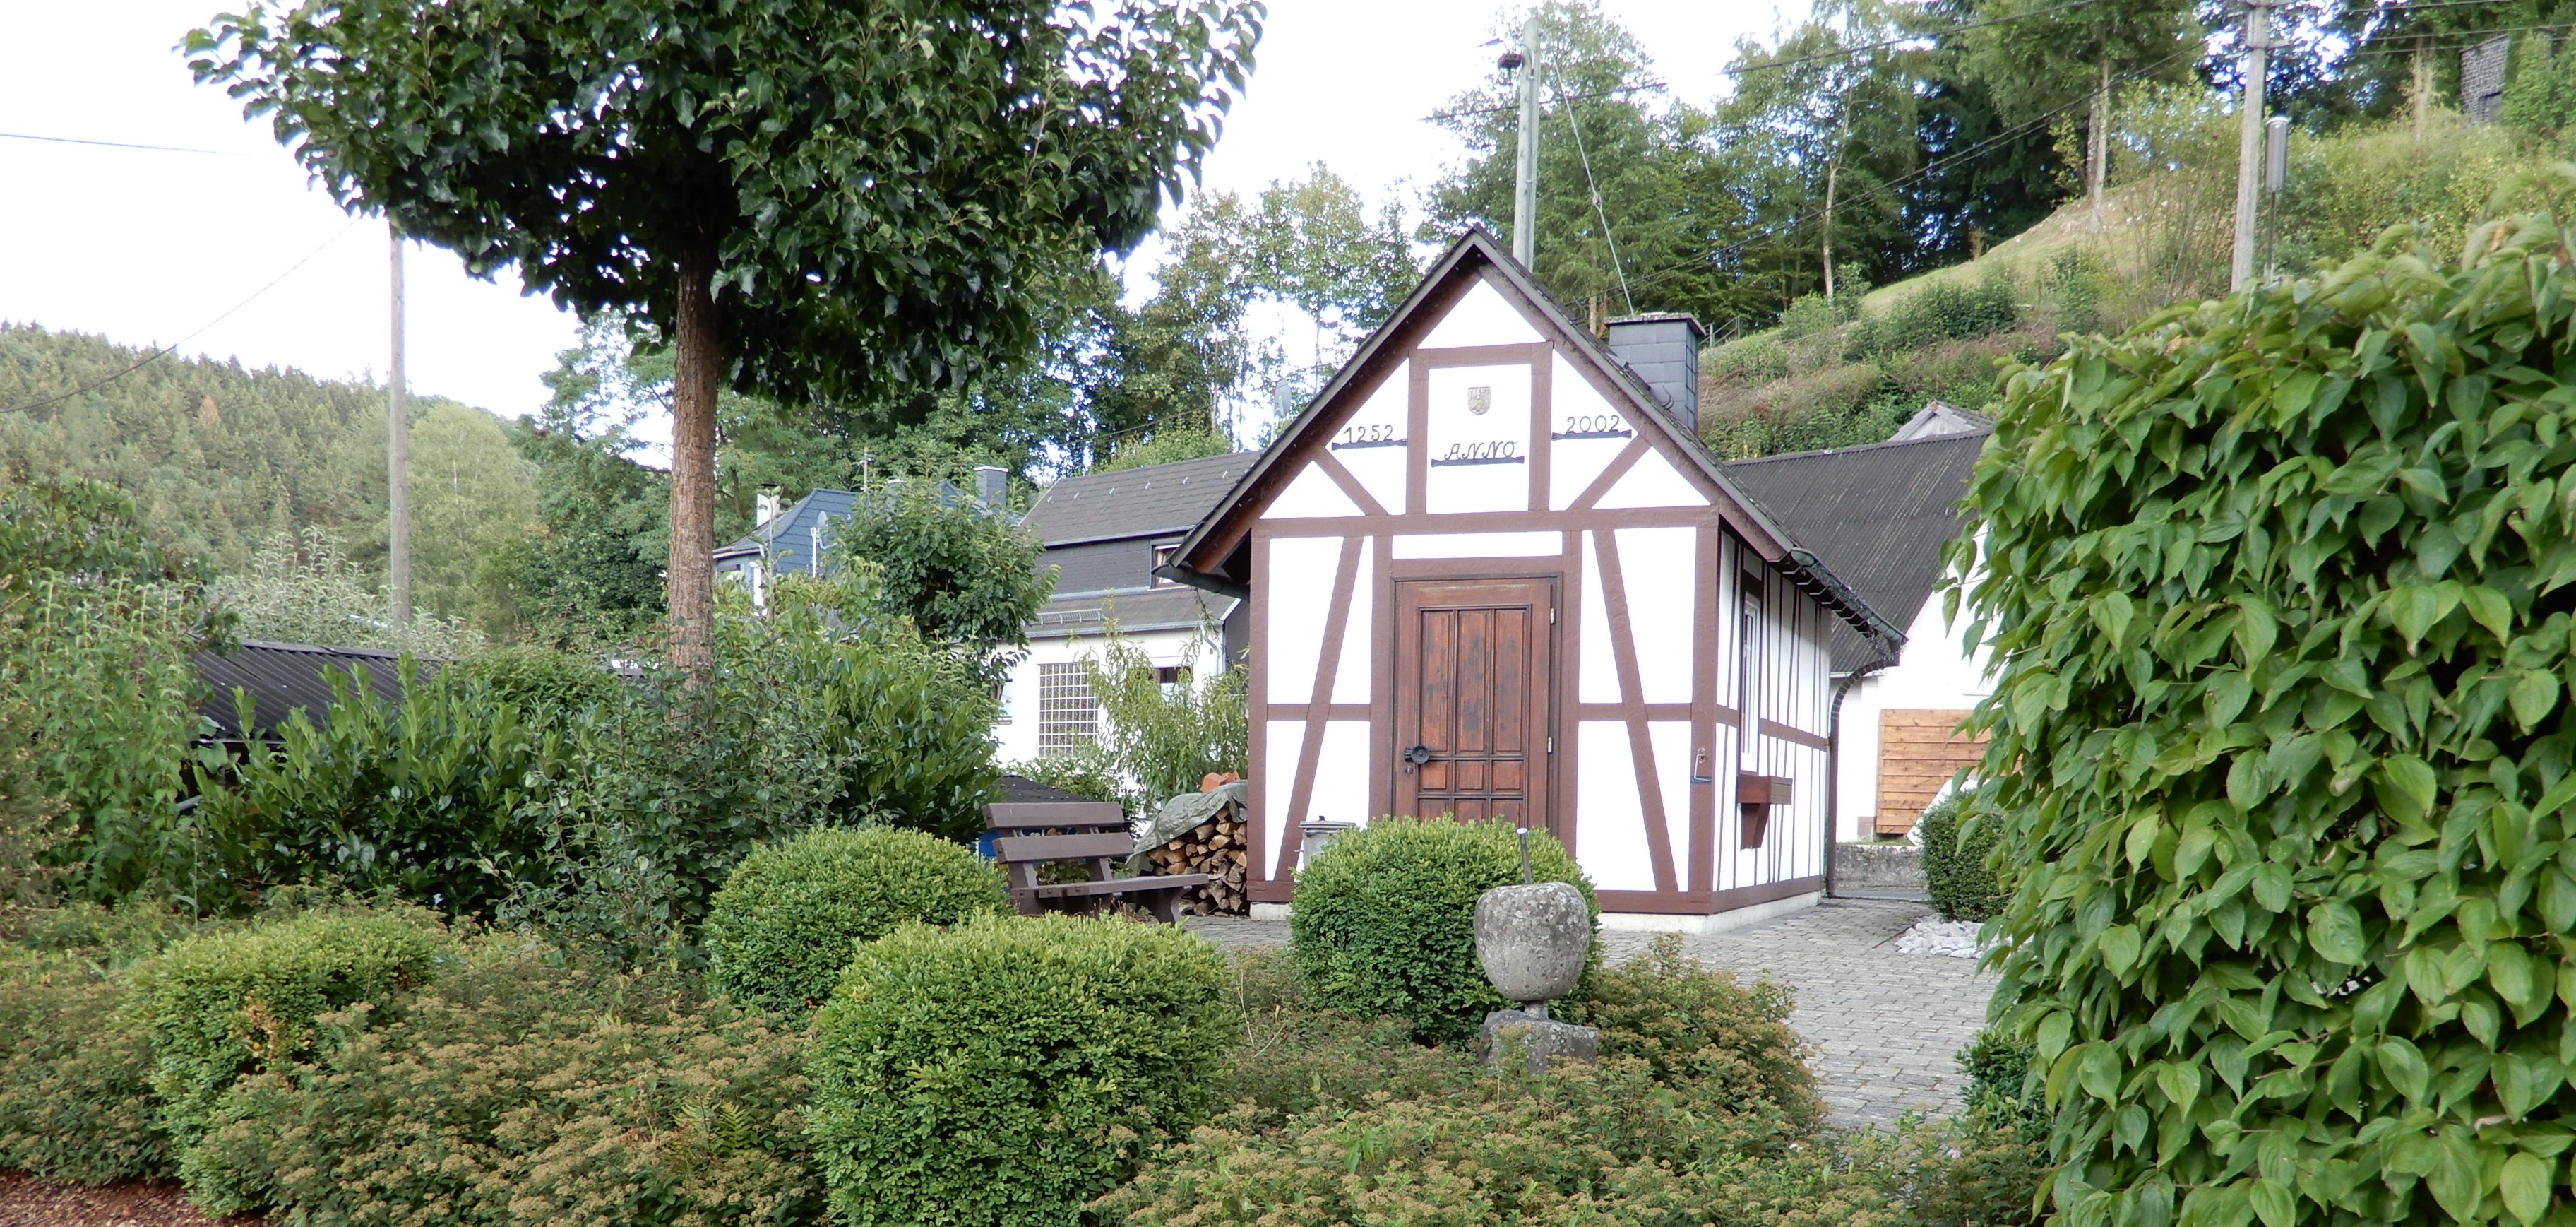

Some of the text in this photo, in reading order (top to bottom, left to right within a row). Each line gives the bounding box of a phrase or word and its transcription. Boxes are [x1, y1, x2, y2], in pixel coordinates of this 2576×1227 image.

[1565, 415, 1619, 433] 2002
[1343, 425, 1393, 443] 1252
[1444, 441, 1517, 460] ANNO
